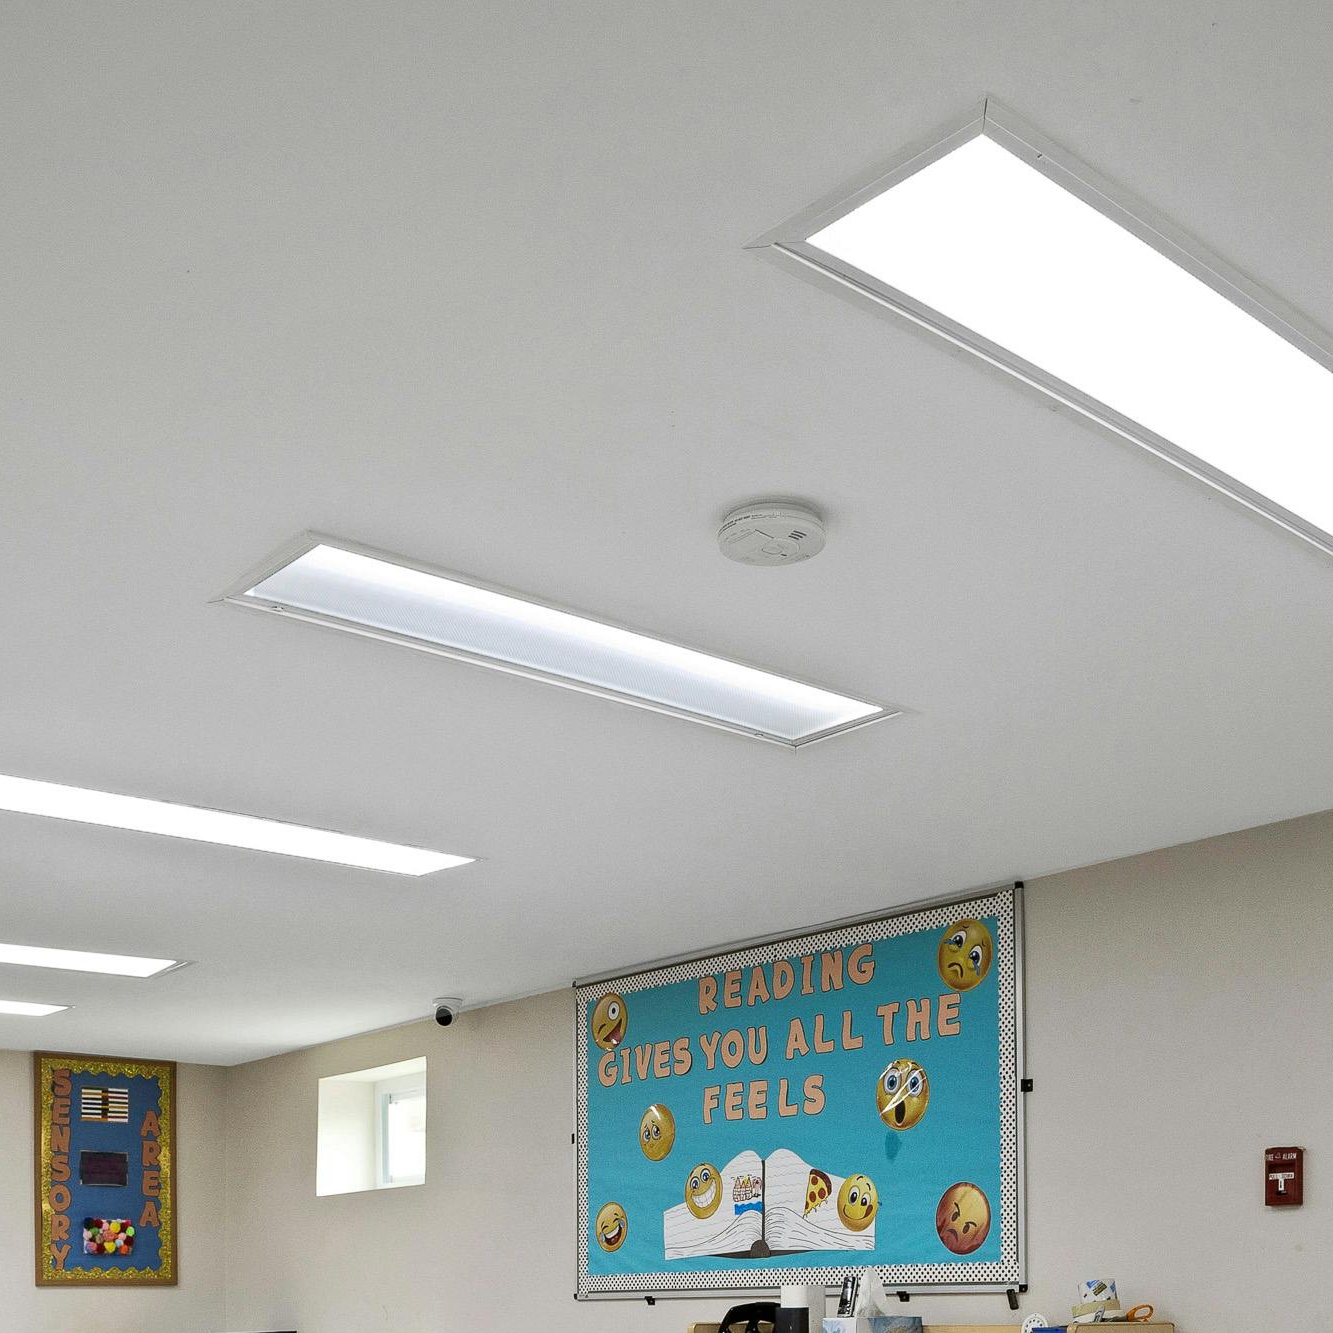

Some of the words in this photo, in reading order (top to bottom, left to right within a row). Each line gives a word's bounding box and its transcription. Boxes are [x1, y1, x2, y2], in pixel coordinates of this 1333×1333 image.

[698, 943, 876, 1015] READING
[598, 1036, 693, 1088] GIVES
[700, 1026, 768, 1071] YOU
[786, 1009, 864, 1060] ALL
[876, 992, 962, 1046] THE
[703, 1074, 826, 1124] FEELS
[49, 1068, 72, 1270] SENSORY
[139, 1110, 161, 1228] AREA
